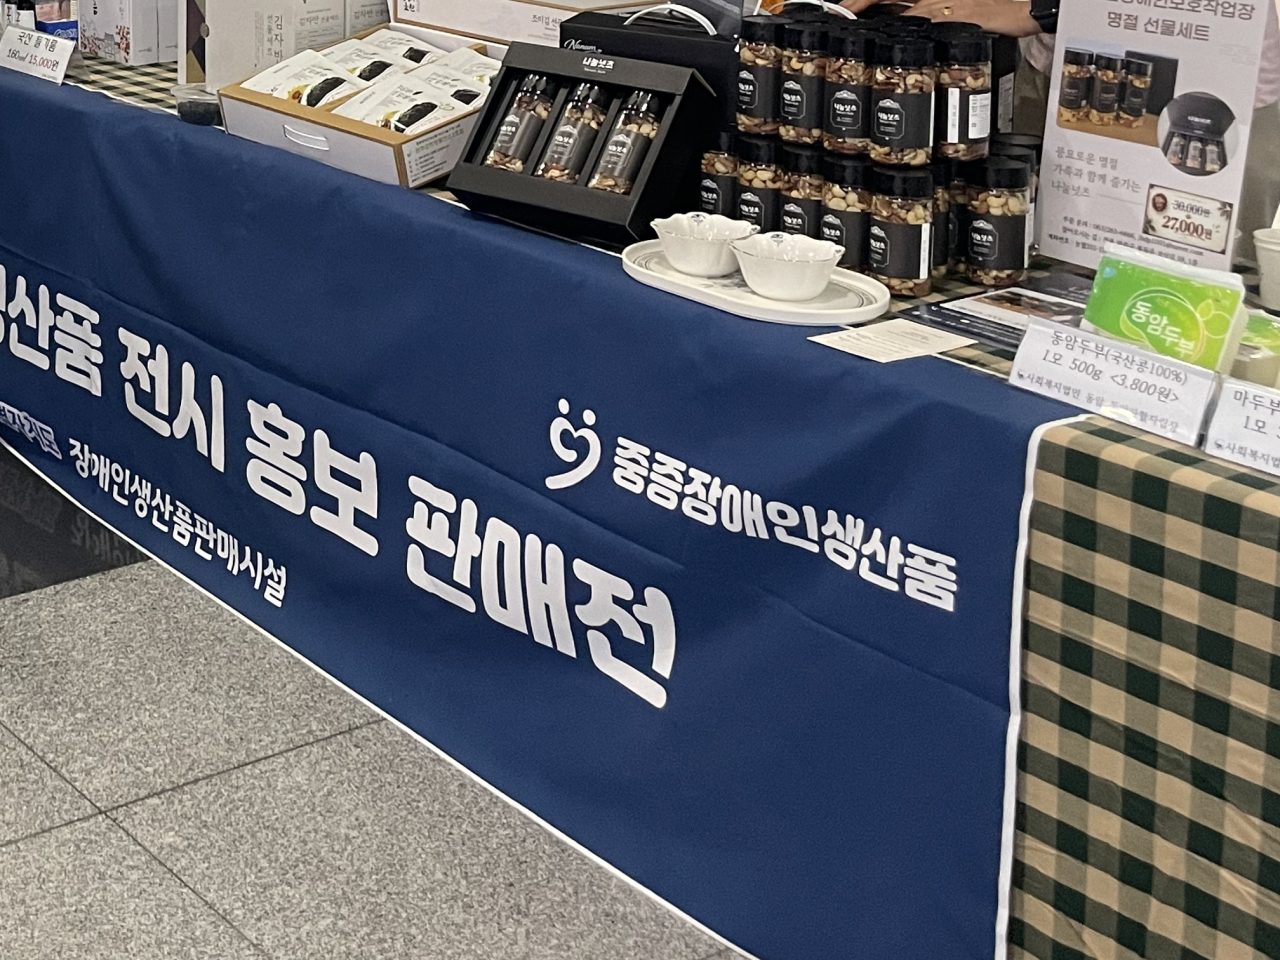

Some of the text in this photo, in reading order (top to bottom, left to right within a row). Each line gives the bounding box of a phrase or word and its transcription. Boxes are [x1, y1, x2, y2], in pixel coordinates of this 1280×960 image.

[1107, 11, 1210, 41] 명절 선물세트
[582, 56, 615, 70] 나눔넛츠
[1055, 146, 1095, 165] 풍요로운
[1110, 176, 1141, 193] 즐기는
[1162, 215, 1212, 241] 27,000원
[1131, 300, 1197, 359] 동암두부
[1051, 329, 1188, 387] 동암두부(국산콩100%)
[1069, 358, 1104, 382] 500g
[69, 438, 287, 607] 장애인생산품판매시설
[118, 326, 677, 708] 전시 홍보 판매전
[612, 436, 957, 612] 중증장애인생산품
